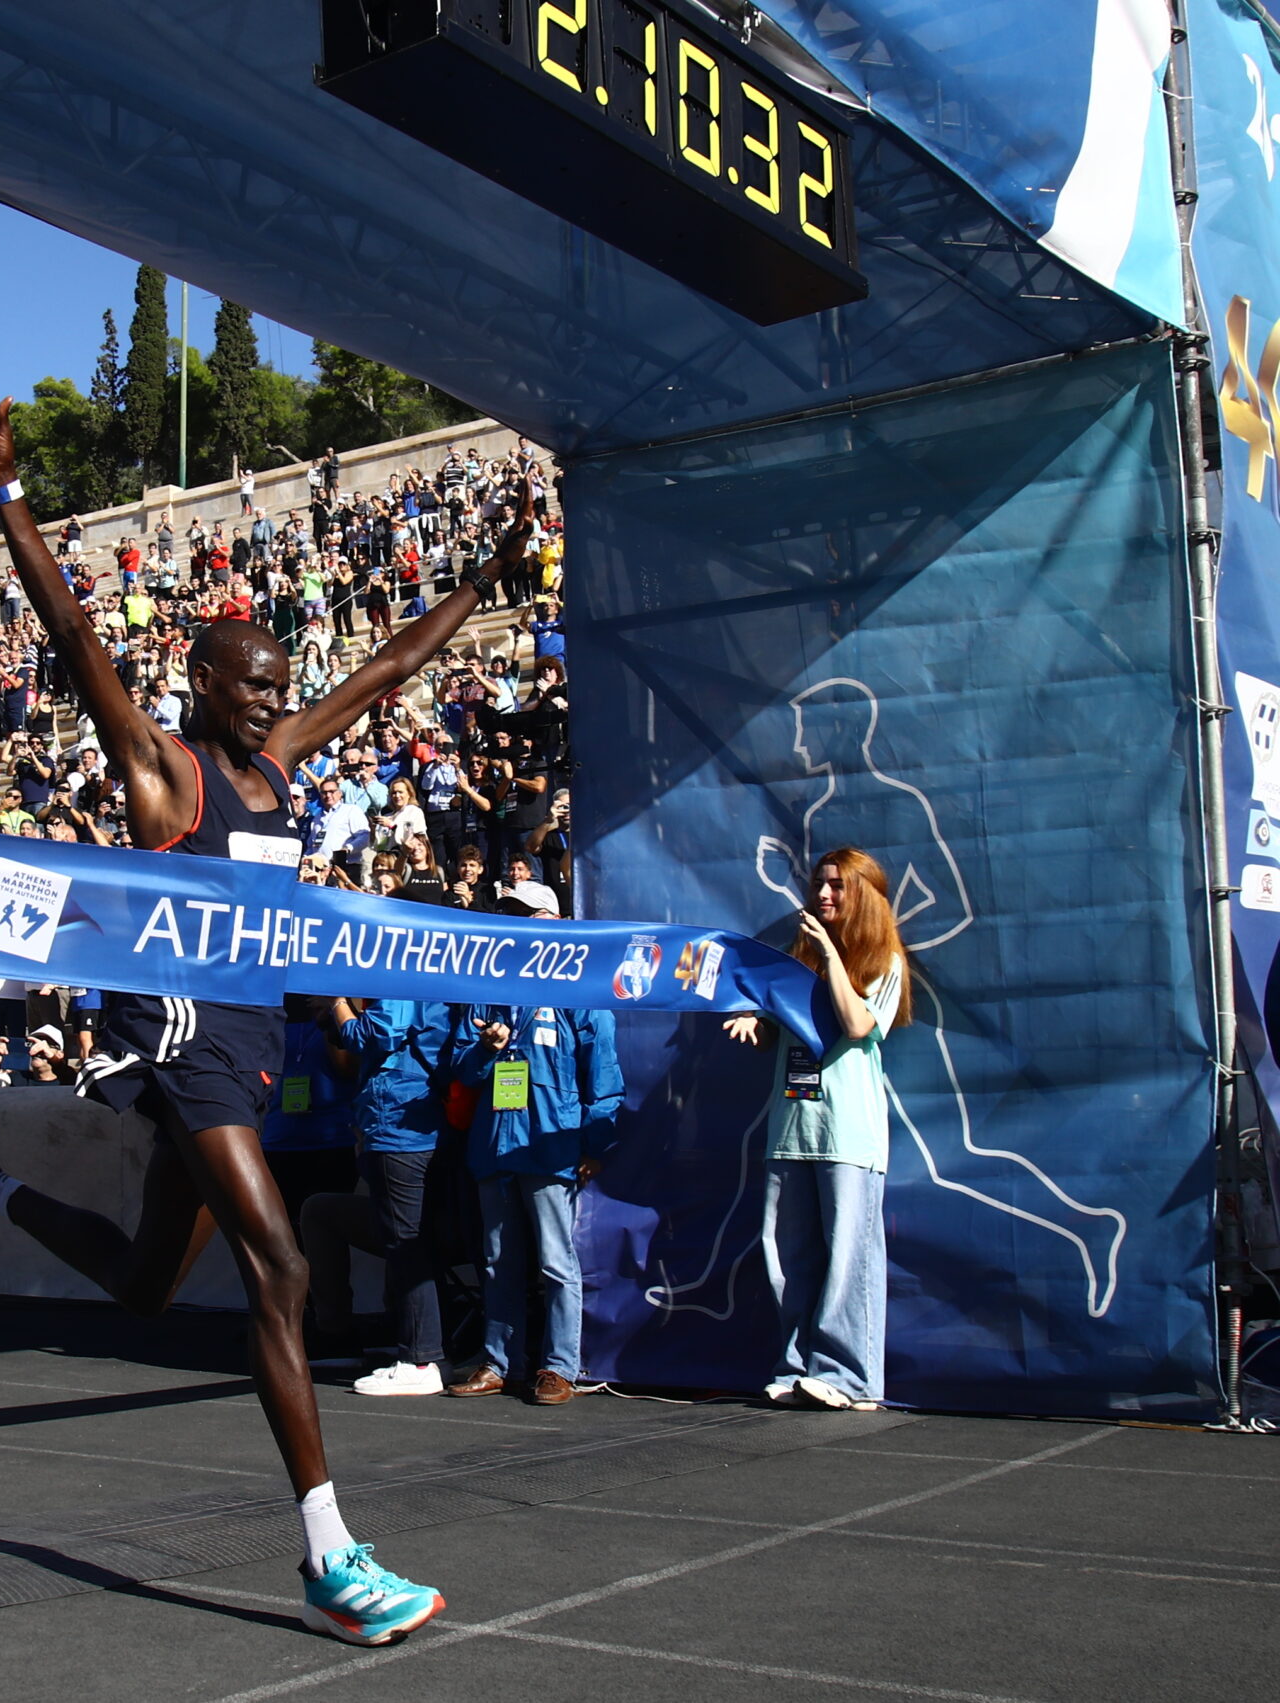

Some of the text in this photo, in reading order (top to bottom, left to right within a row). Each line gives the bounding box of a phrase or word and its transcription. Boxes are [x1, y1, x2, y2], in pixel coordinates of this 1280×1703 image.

[538, 0, 833, 249] 2.10.32
[1, 876, 59, 898] MARATHON
[13, 871, 52, 887] ATHENS
[0, 884, 56, 905] THE AUTHENTIC
[133, 896, 294, 967] ATHE
[326, 921, 516, 978] AUTHENTIC
[519, 940, 589, 982] 2023
